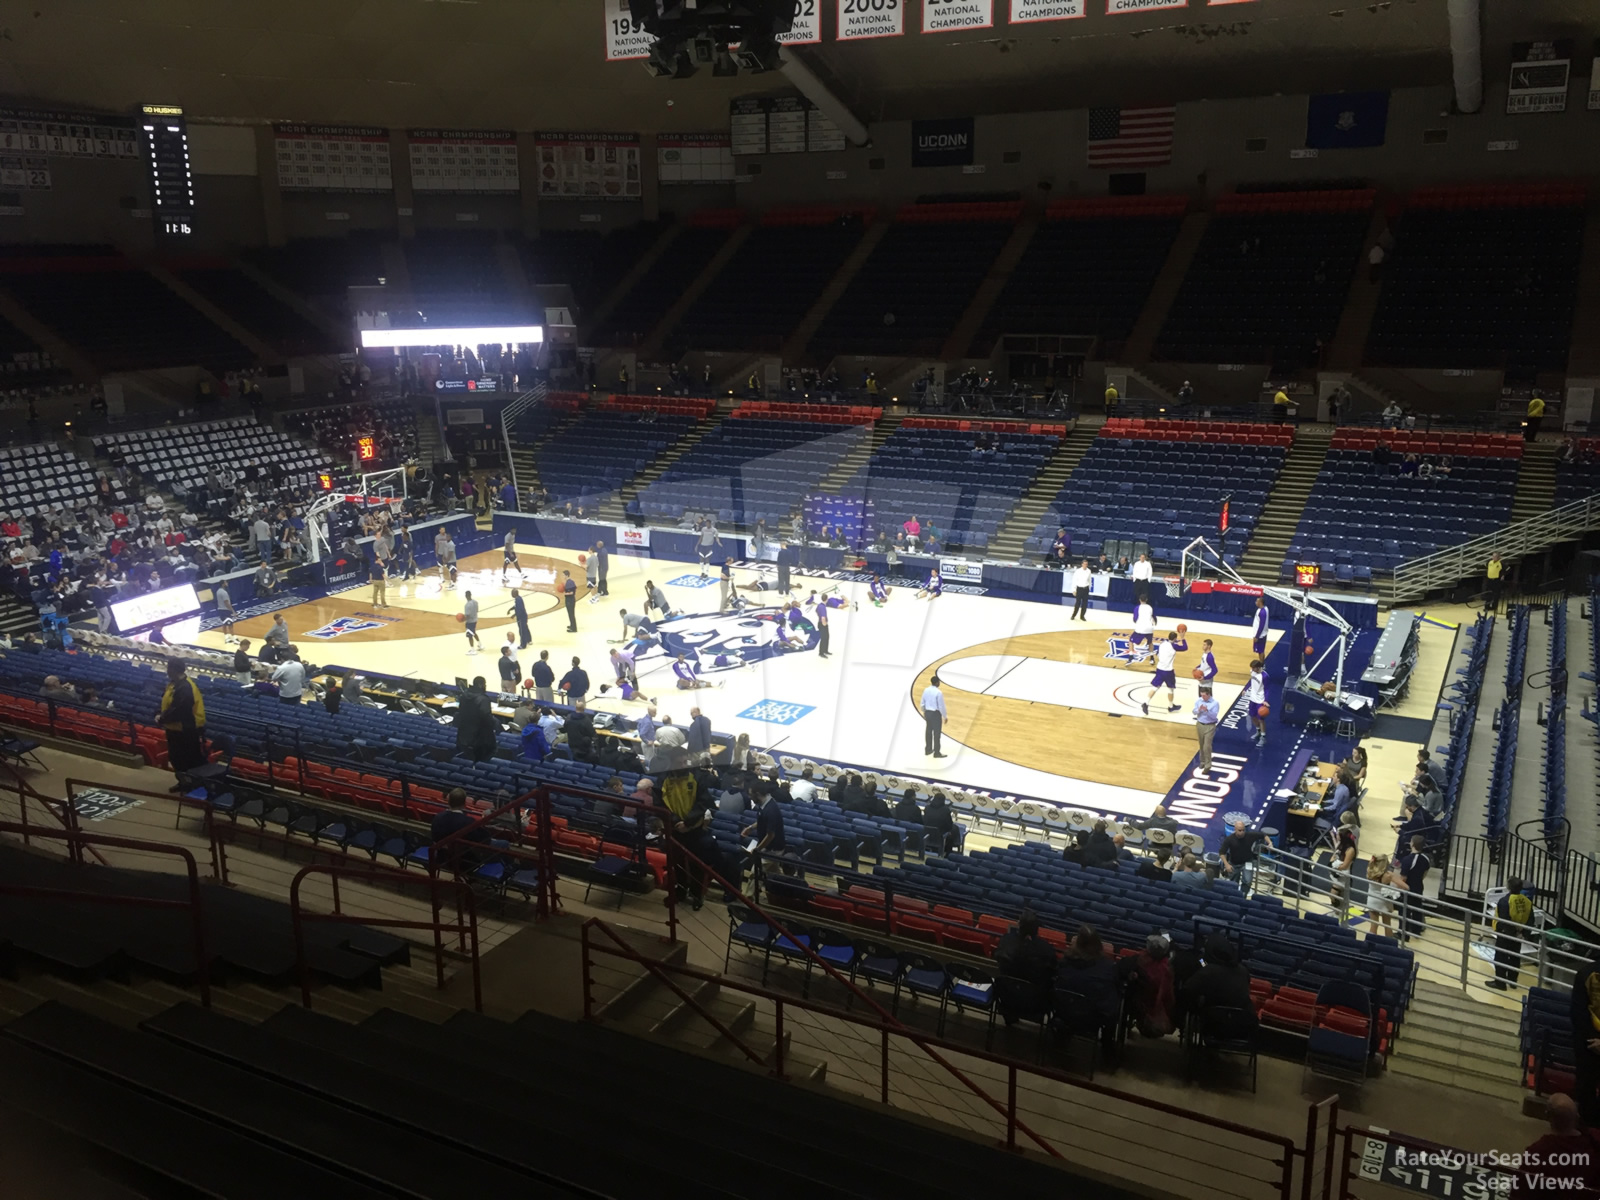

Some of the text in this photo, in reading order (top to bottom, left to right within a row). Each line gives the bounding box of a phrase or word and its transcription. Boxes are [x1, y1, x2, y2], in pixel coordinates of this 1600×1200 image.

[934, 5, 980, 16] NATIONAL
[1018, 6, 1076, 18] CHAMPIONS
[848, 14, 892, 24] NATIONAL
[930, 16, 984, 28] CHAMPIONS
[612, 18, 645, 35] 199
[845, 25, 896, 36] CHAMPIONS
[615, 36, 652, 46] NATIONAL
[776, 31, 814, 41] AMPIONS
[612, 46, 650, 56] CHAMPION
[311, 127, 382, 135] CHAMPIONSHIP
[919, 132, 967, 147] UCONN
[123, 142, 133, 153] 14
[31, 172, 46, 184] 23
[362, 446, 372, 458] 30
[1296, 565, 1319, 574] 42:01
[329, 572, 356, 583] TRAVELERS
[1302, 575, 1313, 584] 30
[1222, 710, 1248, 730] Court
[1167, 752, 1248, 828] UCONN
[84, 792, 119, 805] 120
[75, 804, 110, 817] 121
